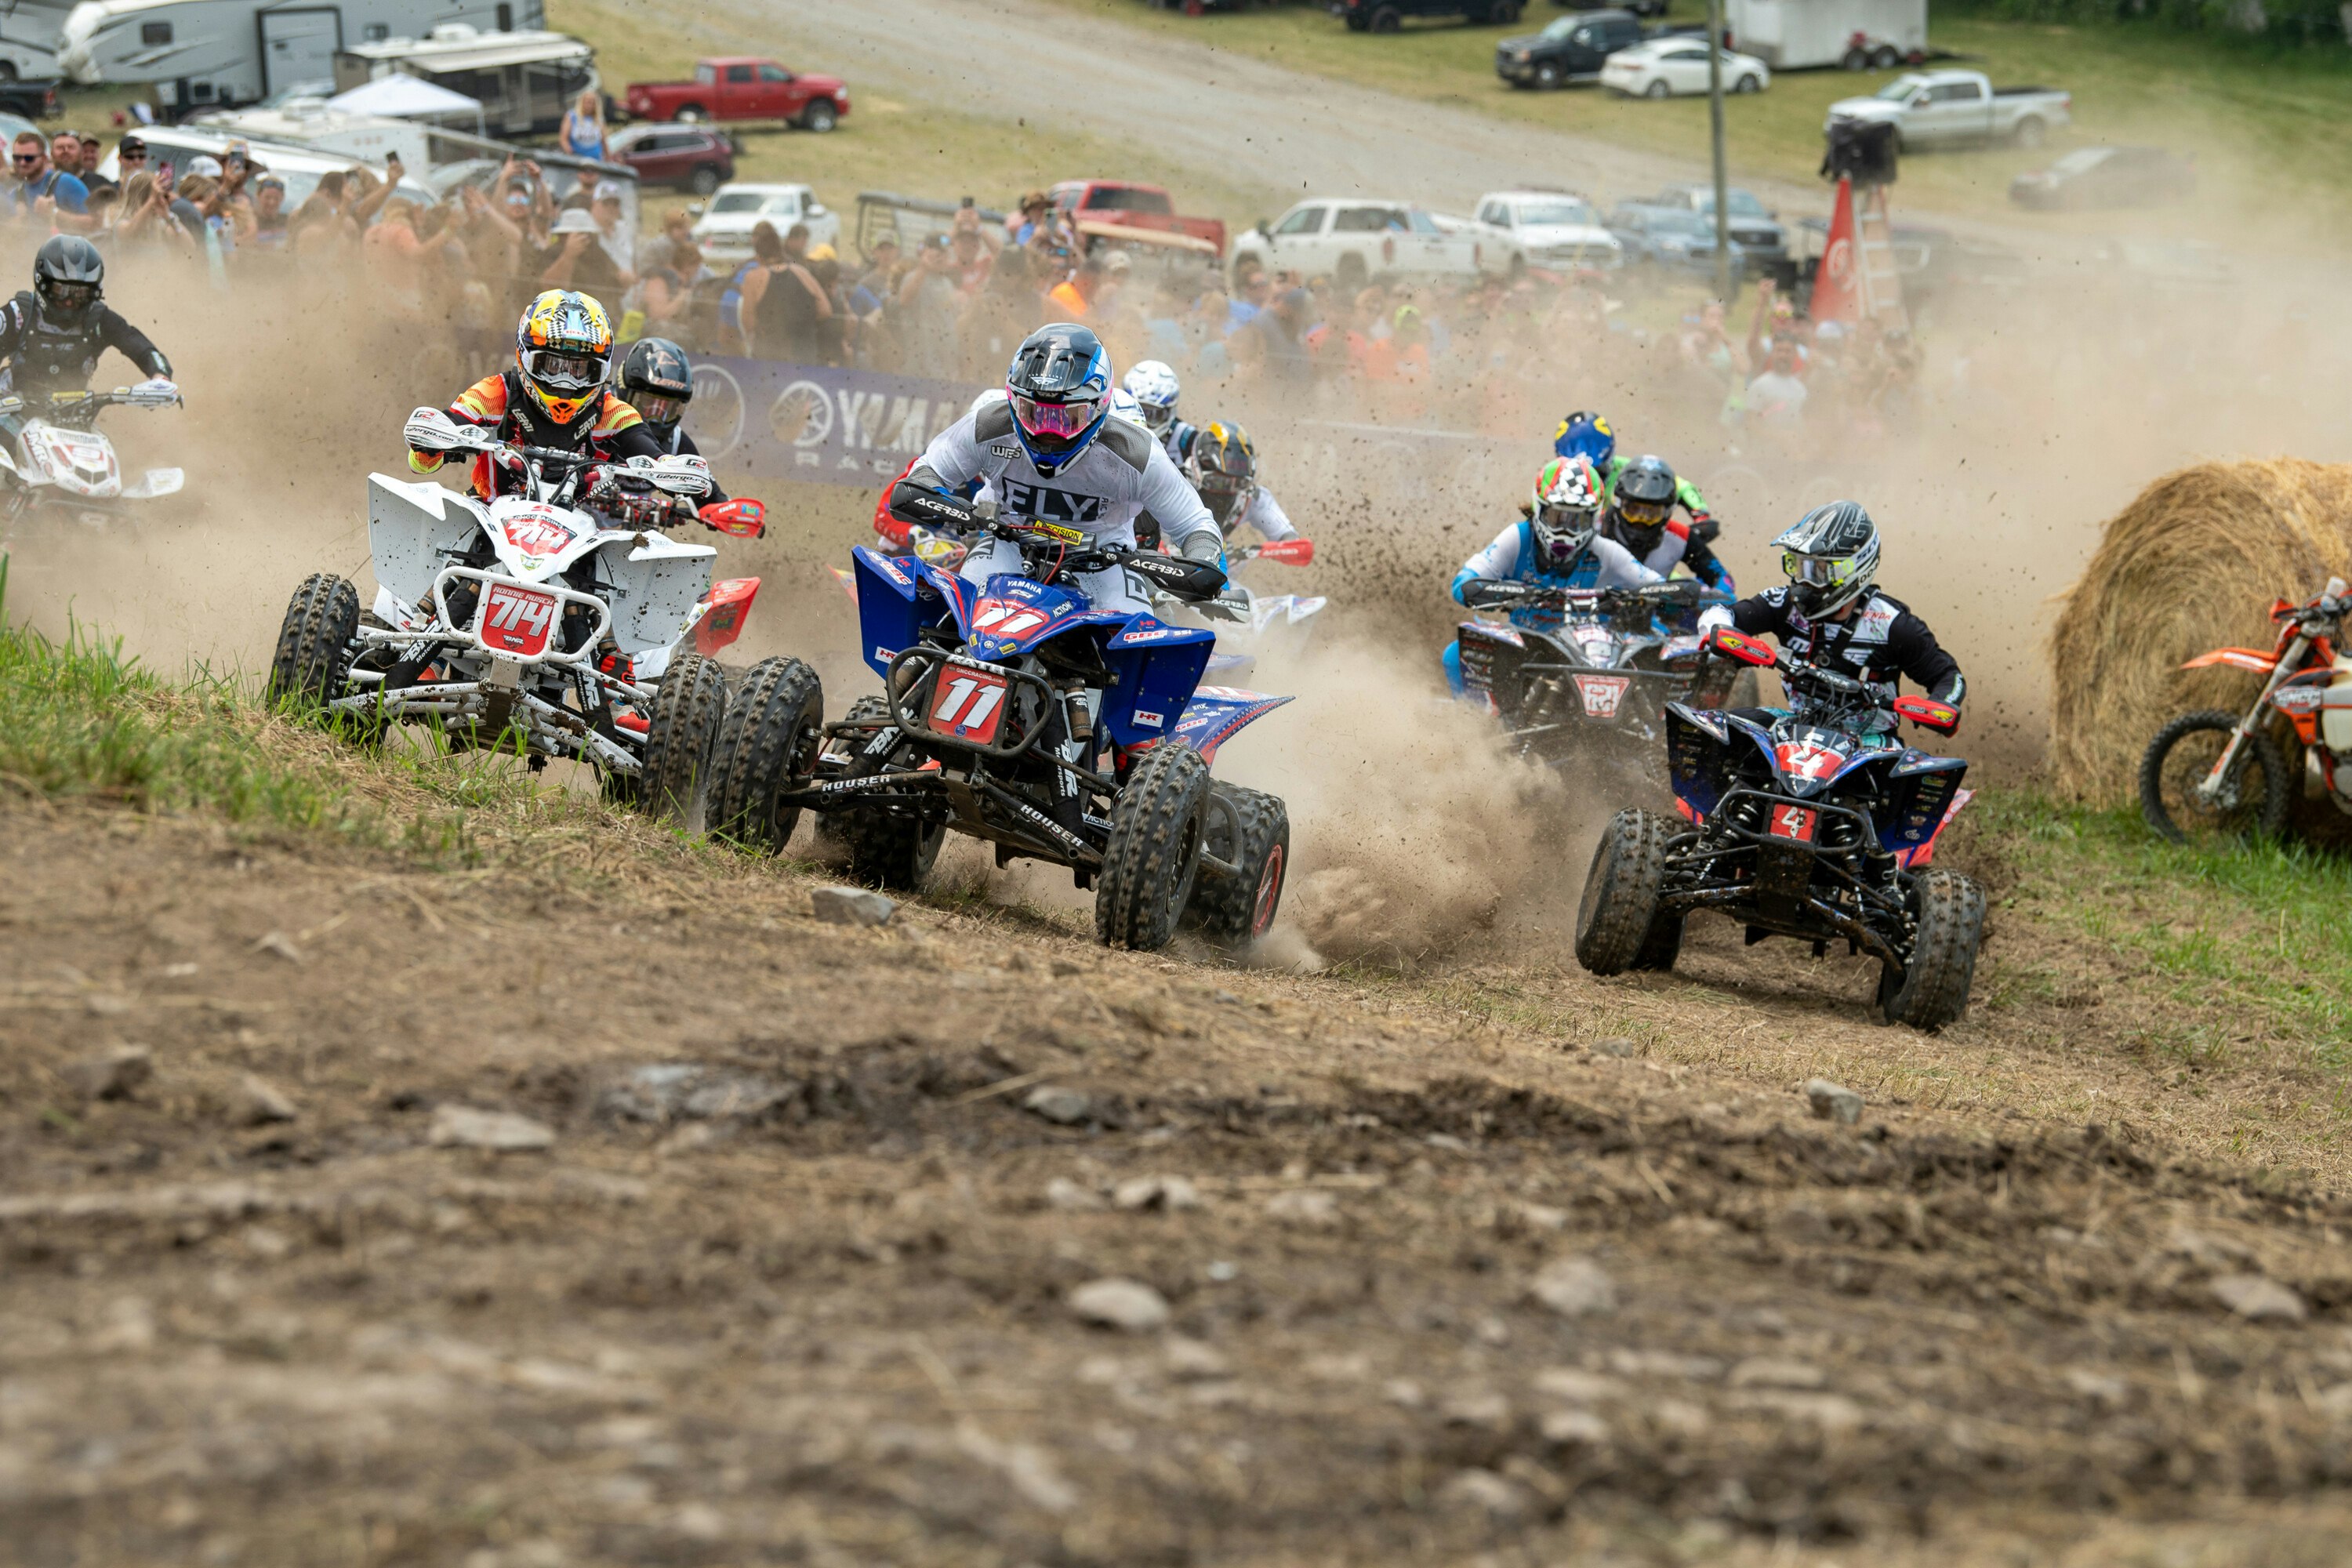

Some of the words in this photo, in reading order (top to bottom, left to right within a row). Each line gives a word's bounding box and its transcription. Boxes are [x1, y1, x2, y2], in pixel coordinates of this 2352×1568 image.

[654, 378, 687, 389] LEATT
[511, 408, 535, 432] LEATT
[574, 412, 597, 441] LEATT
[837, 390, 958, 455] YAMA
[794, 451, 896, 475] RAC
[914, 497, 971, 521] ACERBIS
[1005, 482, 1094, 523] FLY
[507, 521, 569, 550] 714
[1128, 557, 1185, 578] ACERBIS
[492, 586, 524, 600] RONNIE
[524, 593, 555, 606] RUSCH
[1007, 579, 1043, 596] YAMAHA
[488, 593, 554, 638] 714
[1211, 598, 1249, 611] ACERBIS
[971, 607, 1045, 634] 11
[1124, 630, 1168, 641] GBC
[416, 640, 438, 663] Motors
[945, 654, 1006, 677] RATH
[575, 671, 588, 711] otorsports
[933, 677, 1007, 730] 11
[1139, 712, 1159, 722] HR
[1786, 743, 1825, 779] 4
[822, 774, 891, 793] HOUSER
[1020, 804, 1083, 848] HOUSER
[1780, 807, 1807, 838] 4
